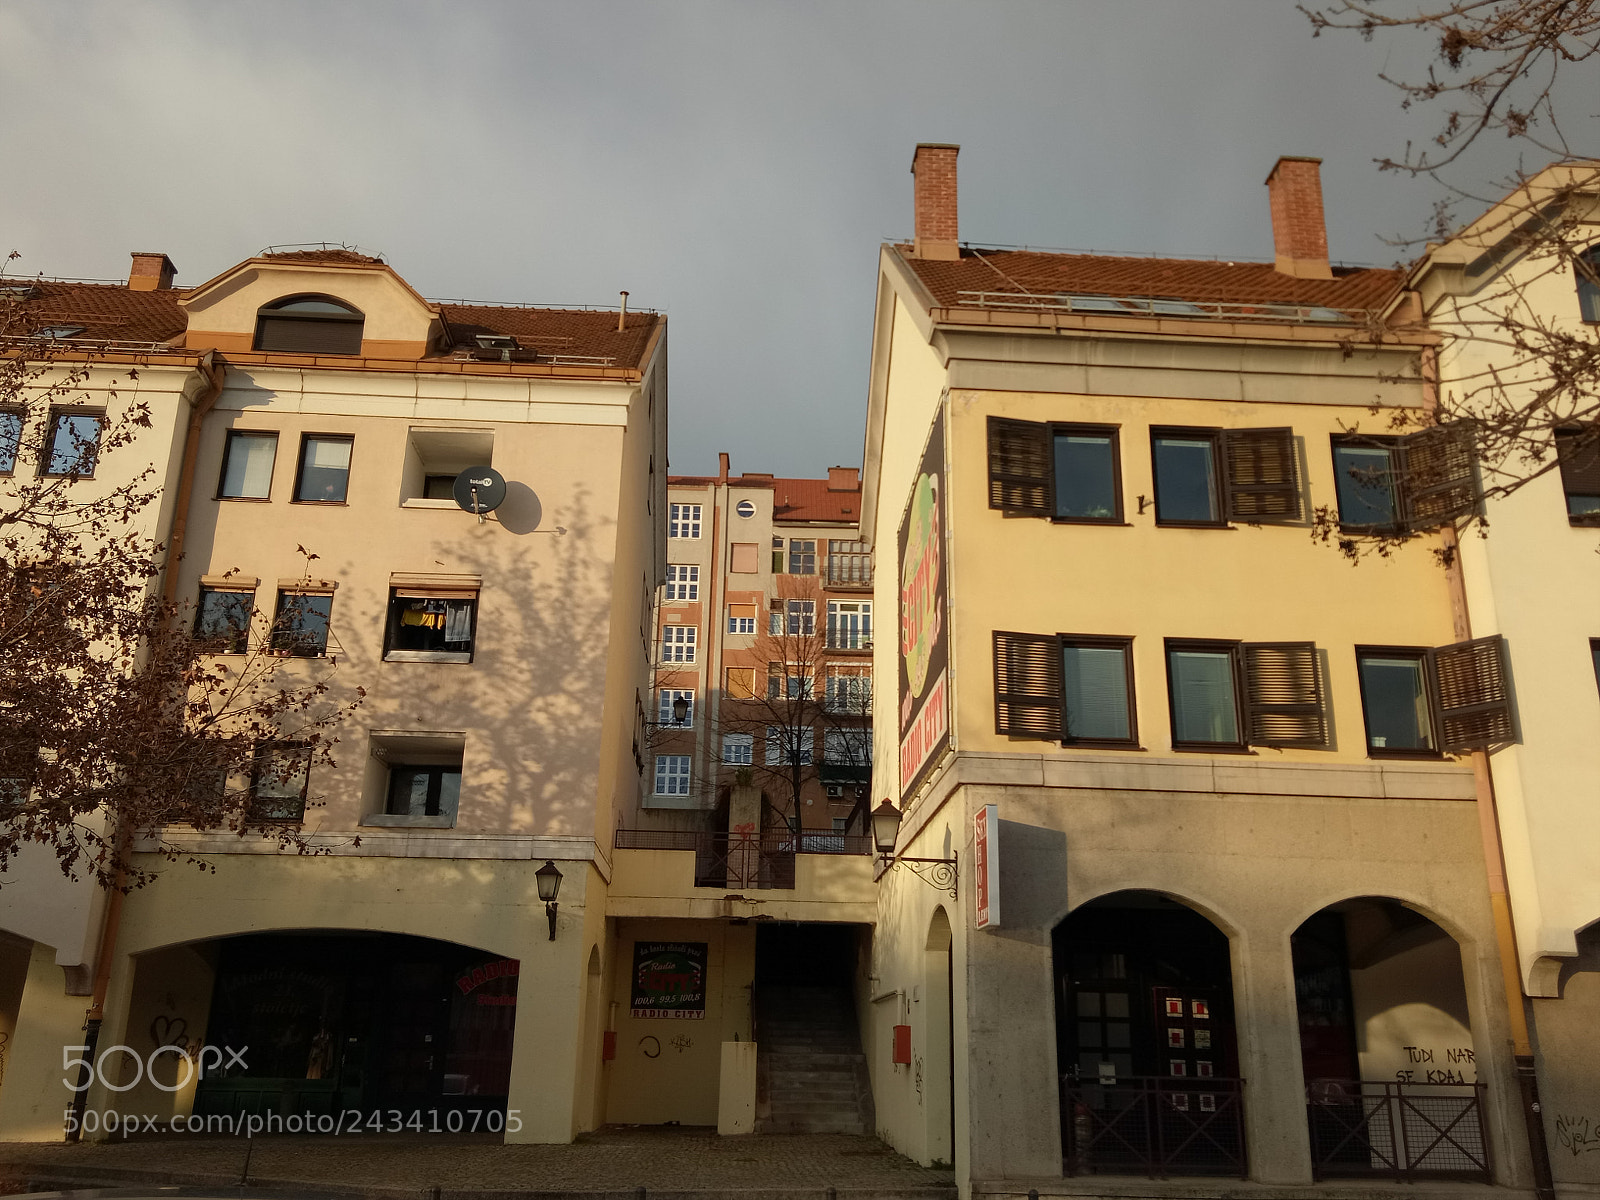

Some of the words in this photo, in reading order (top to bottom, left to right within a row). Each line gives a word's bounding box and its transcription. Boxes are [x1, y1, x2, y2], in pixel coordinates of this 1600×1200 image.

[902, 717, 921, 787] RADIO
[924, 679, 942, 755] CITY
[651, 962, 676, 970] Radio
[456, 959, 520, 995] RADIO
[633, 1009, 669, 1018] RADIO
[674, 1009, 703, 1019] CITY
[1403, 1046, 1434, 1063] TUDI
[1396, 1070, 1416, 1085] SE
